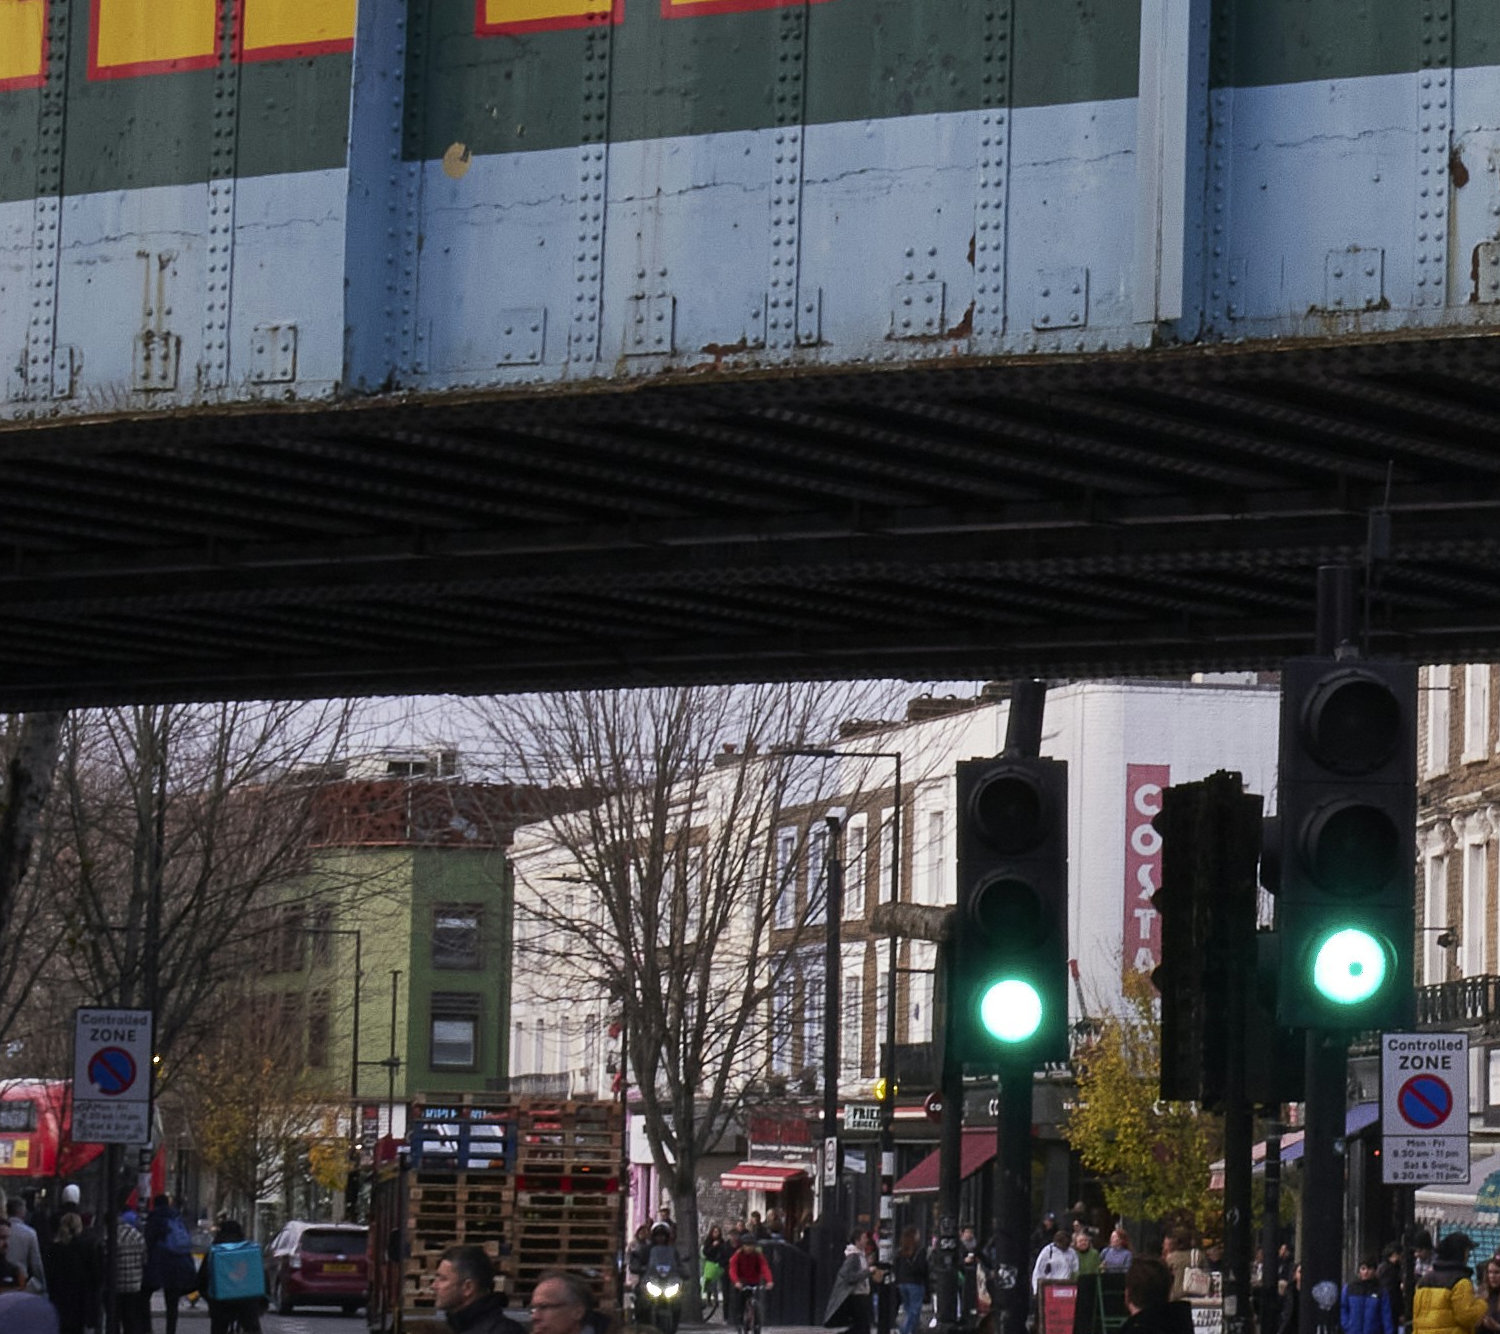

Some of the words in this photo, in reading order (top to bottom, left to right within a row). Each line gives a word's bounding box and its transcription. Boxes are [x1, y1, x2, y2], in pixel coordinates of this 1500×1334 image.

[1131, 784, 1163, 973] COSTA
[81, 1013, 148, 1026] Controlled
[90, 1029, 136, 1042] ZONE
[1388, 1039, 1463, 1051] Controlled
[1399, 1056, 1452, 1070] ZONE
[1446, 1151, 1459, 1159] pm
